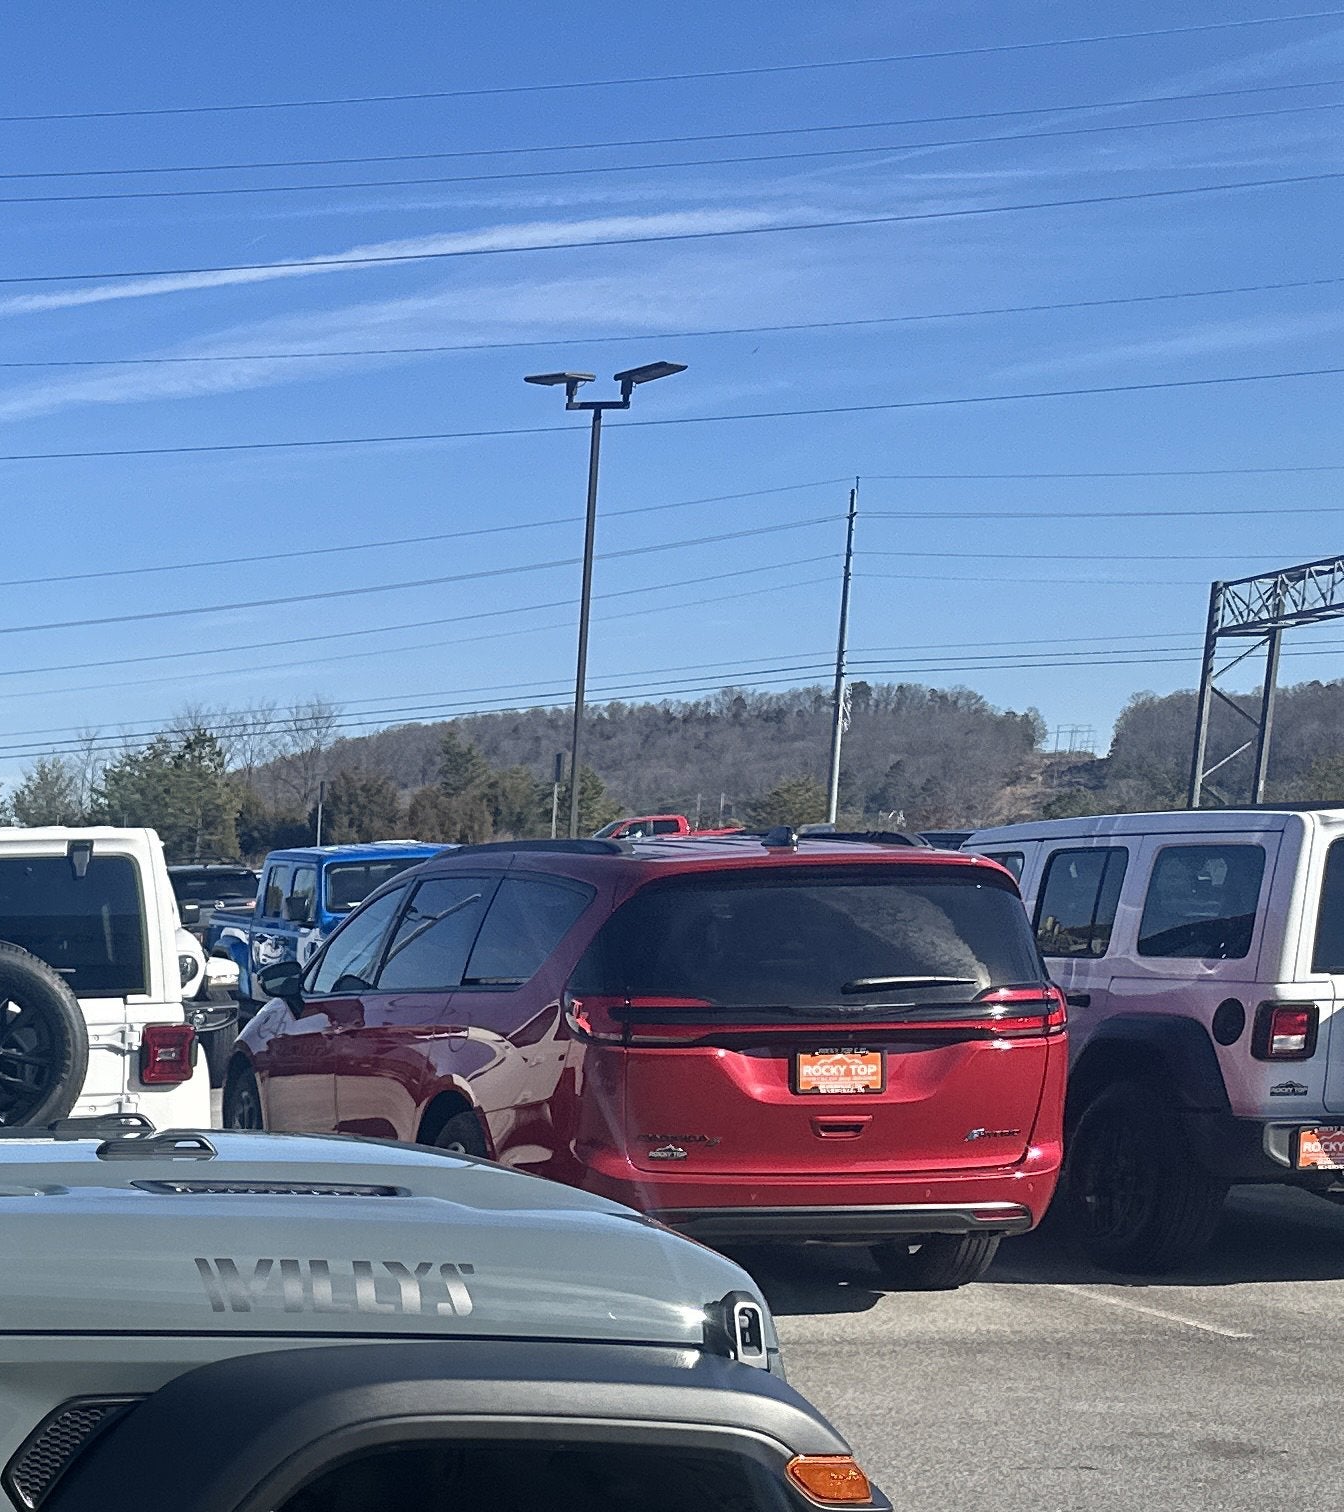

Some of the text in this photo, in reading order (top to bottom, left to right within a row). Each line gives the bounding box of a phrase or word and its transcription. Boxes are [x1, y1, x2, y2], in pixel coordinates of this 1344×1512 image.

[802, 1065, 877, 1076] ROCKY TOP
[1303, 1142, 1344, 1153] ROCKY
[194, 1257, 475, 1317] WILLYS
